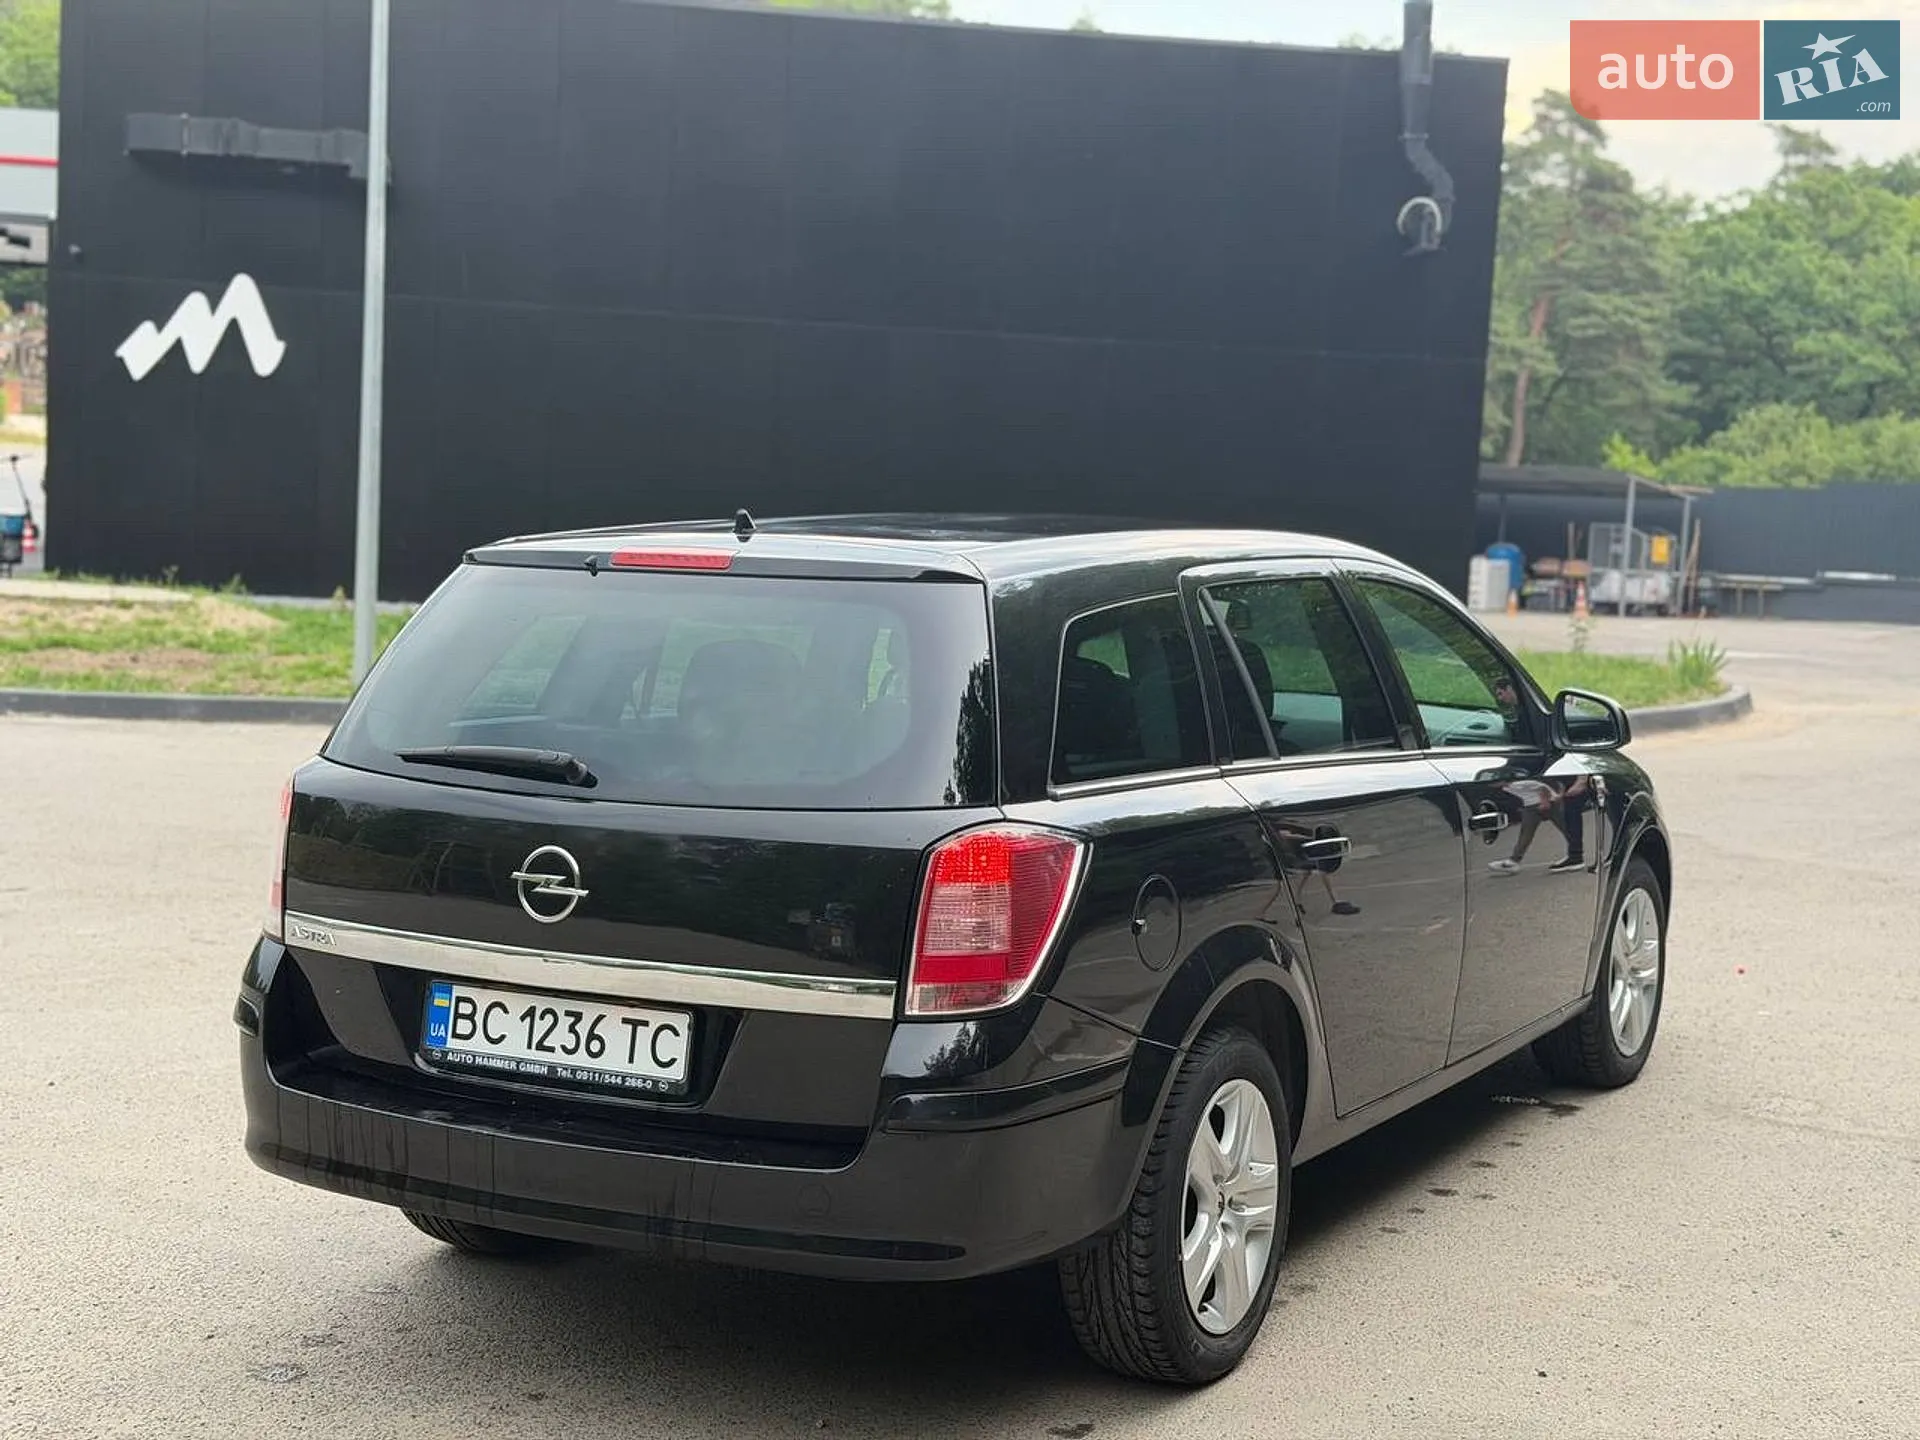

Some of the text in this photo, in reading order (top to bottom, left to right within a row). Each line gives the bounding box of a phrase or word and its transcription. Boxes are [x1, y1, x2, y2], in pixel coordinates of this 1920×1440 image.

[291, 925, 336, 946] ASTRA
[430, 1023, 446, 1037] UA
[451, 995, 681, 1069] BC 1236 TC
[447, 1052, 473, 1063] AUTO
[475, 1056, 517, 1070] HAMMER
